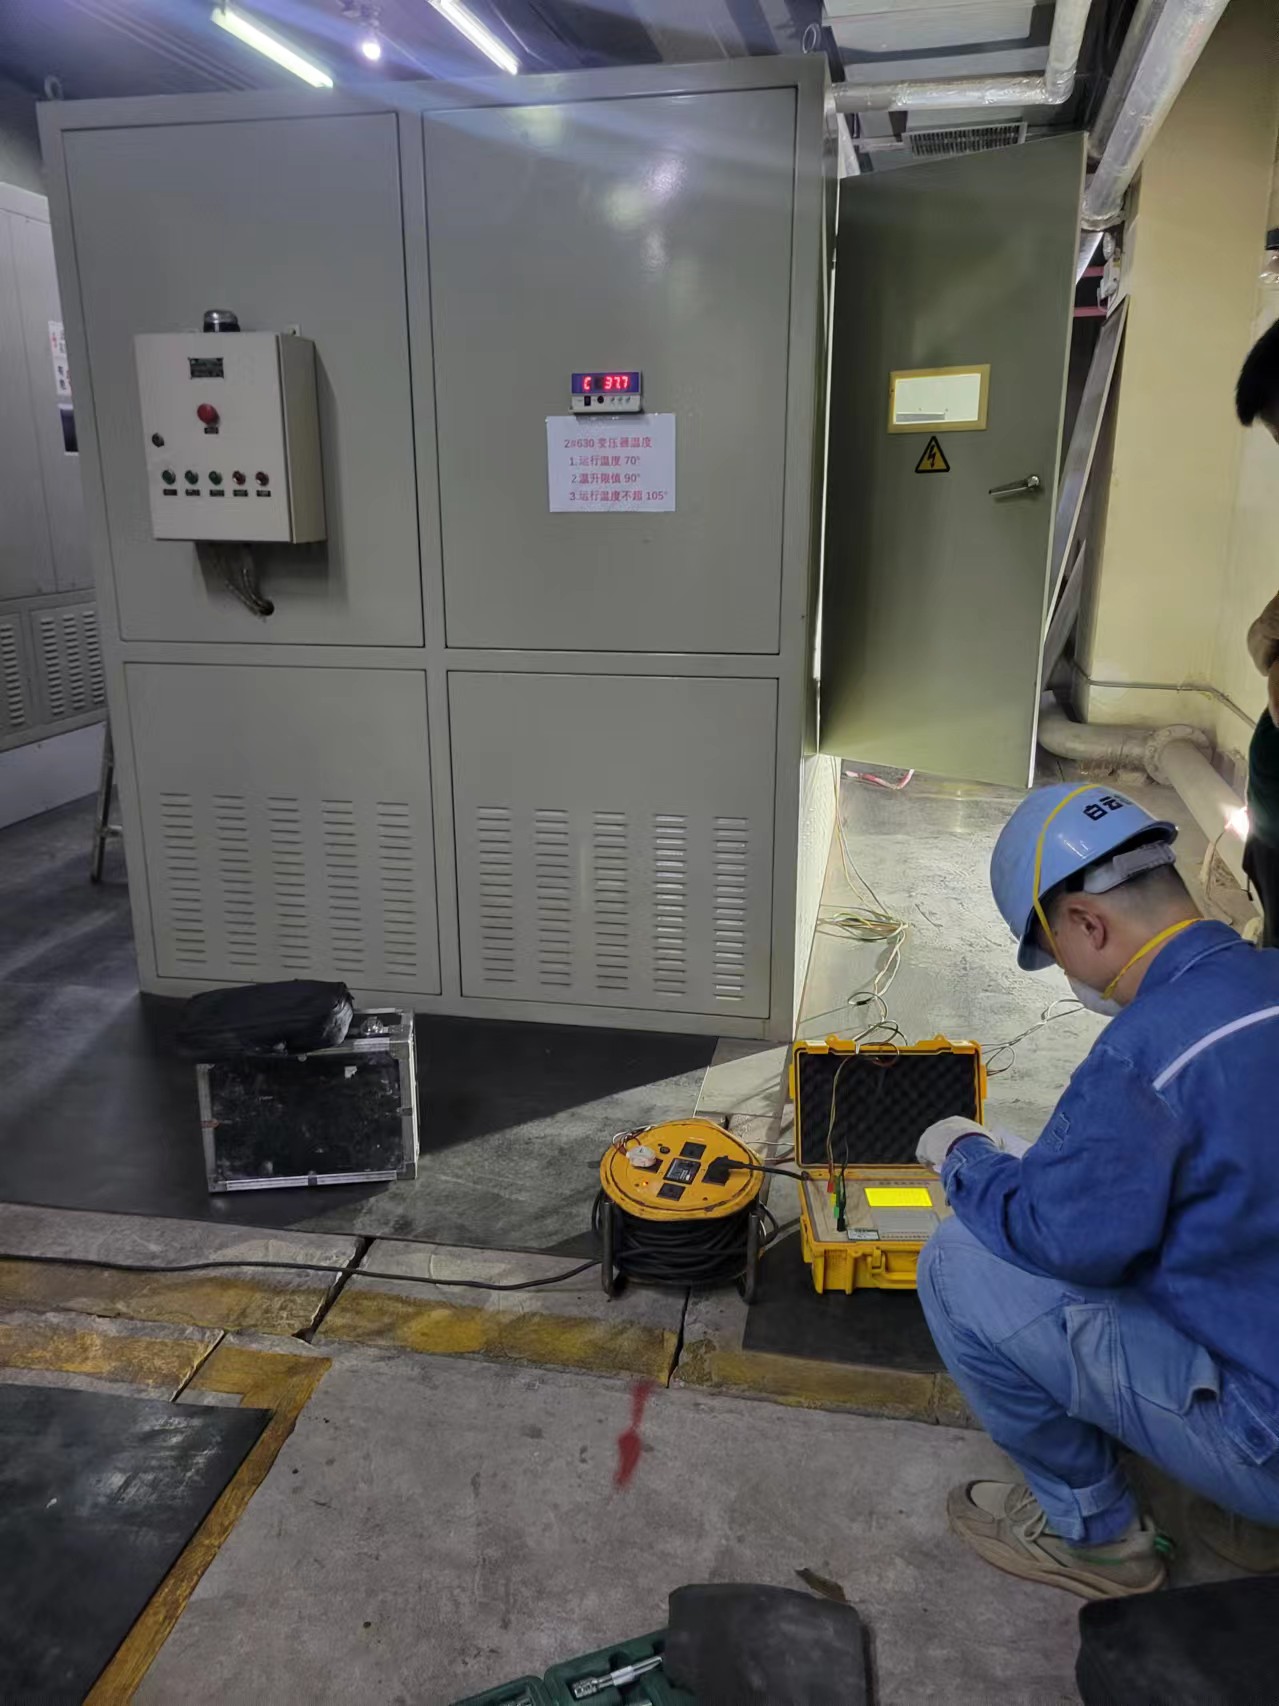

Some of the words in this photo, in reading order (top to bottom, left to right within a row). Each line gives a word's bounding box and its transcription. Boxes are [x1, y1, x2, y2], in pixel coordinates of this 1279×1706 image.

[564, 438, 595, 449] 2#630
[597, 436, 653, 449] 变压器温度
